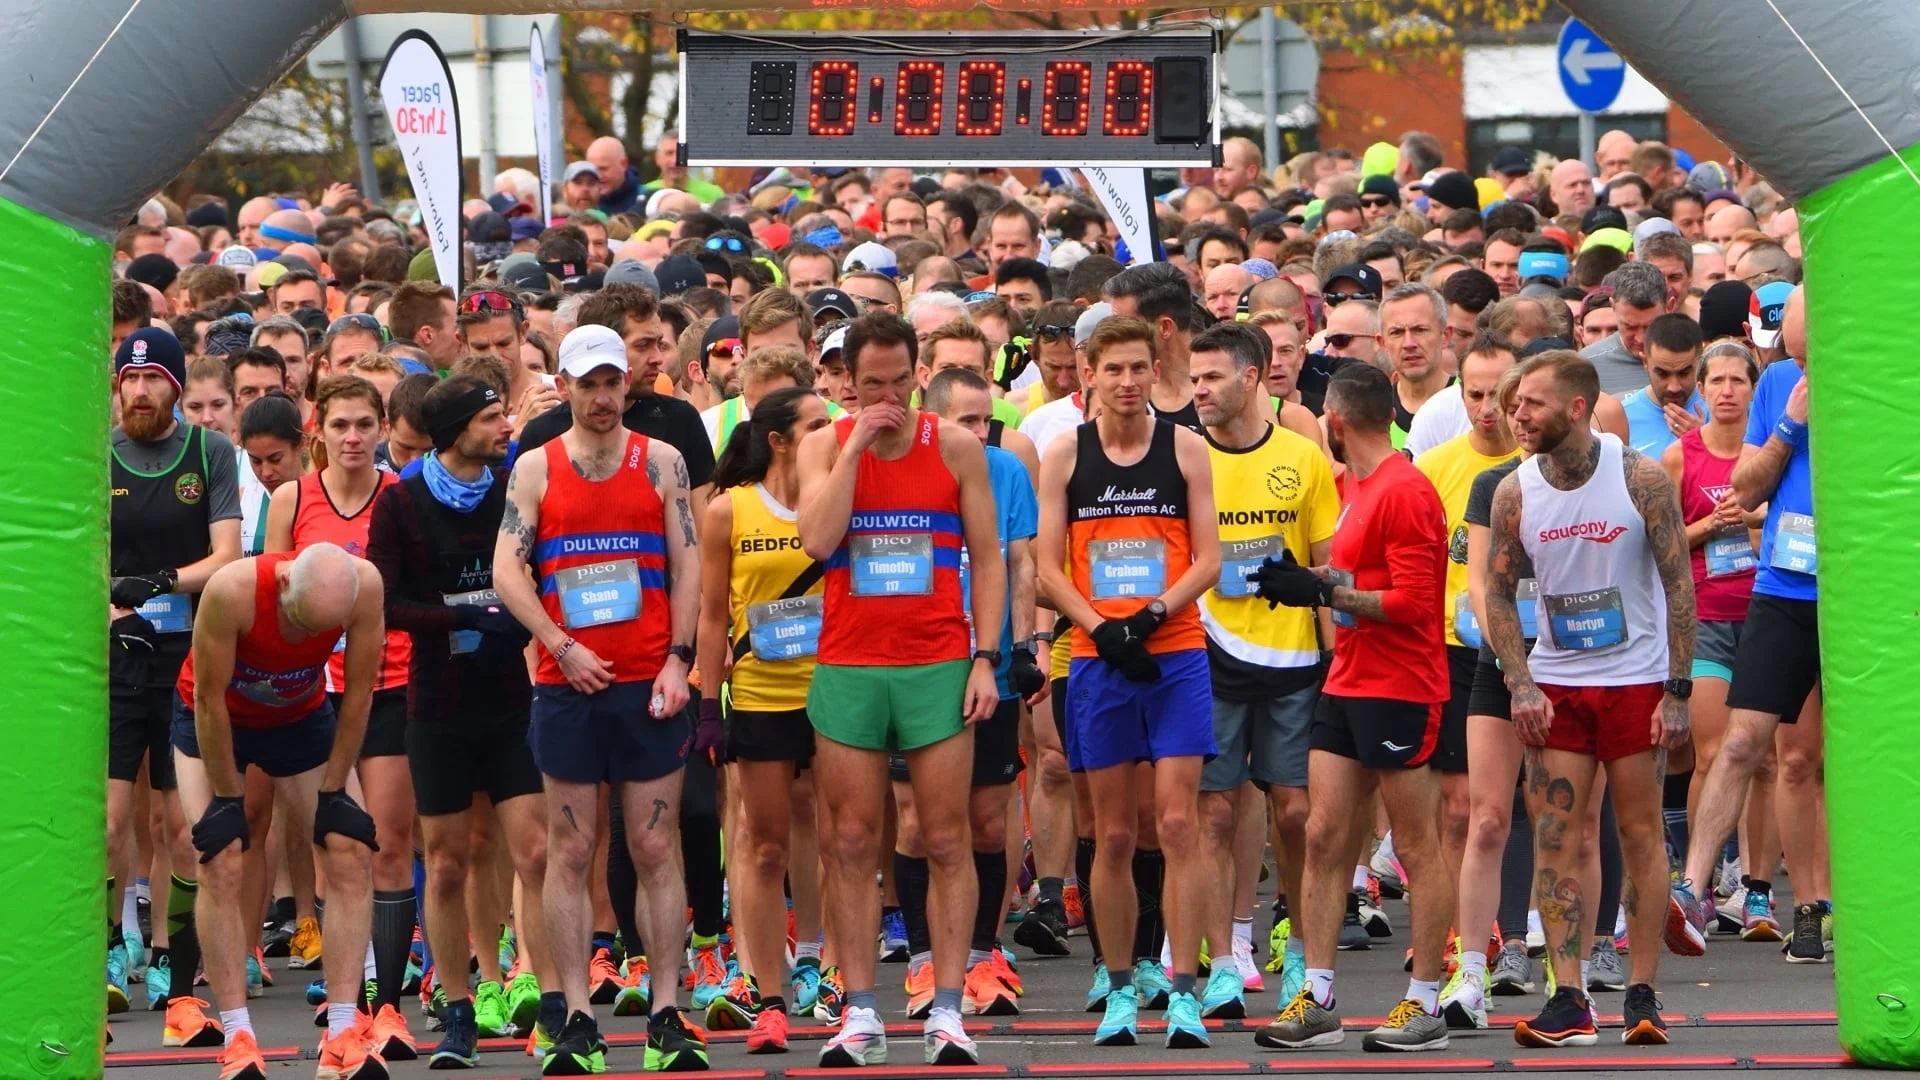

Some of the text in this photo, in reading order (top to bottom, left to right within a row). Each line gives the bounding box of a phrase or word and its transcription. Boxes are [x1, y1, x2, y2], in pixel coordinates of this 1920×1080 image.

[808, 61, 1154, 136] 0:00:00
[1097, 485, 1157, 502] Marshall
[1078, 504, 1177, 518] Milton Keynes AC
[1218, 510, 1299, 526] MONTON
[852, 515, 931, 529] DULWICH
[1539, 520, 1608, 543] saucony
[563, 537, 640, 553] DULWICH
[871, 534, 912, 549] pico
[1107, 538, 1147, 553] pico
[1233, 538, 1269, 554] pico
[577, 563, 617, 580] pico
[867, 559, 917, 575] Timothy
[1104, 563, 1150, 578] Graham
[885, 580, 900, 592] 117
[1246, 582, 1261, 593] 26
[581, 589, 619, 605] Shane
[1563, 591, 1600, 608] pico
[592, 607, 613, 621] 955
[768, 599, 807, 615] pico
[774, 623, 806, 640] Lucie
[1566, 617, 1605, 633] Martyn
[785, 643, 802, 656] 311
[1581, 637, 1594, 648] 76
